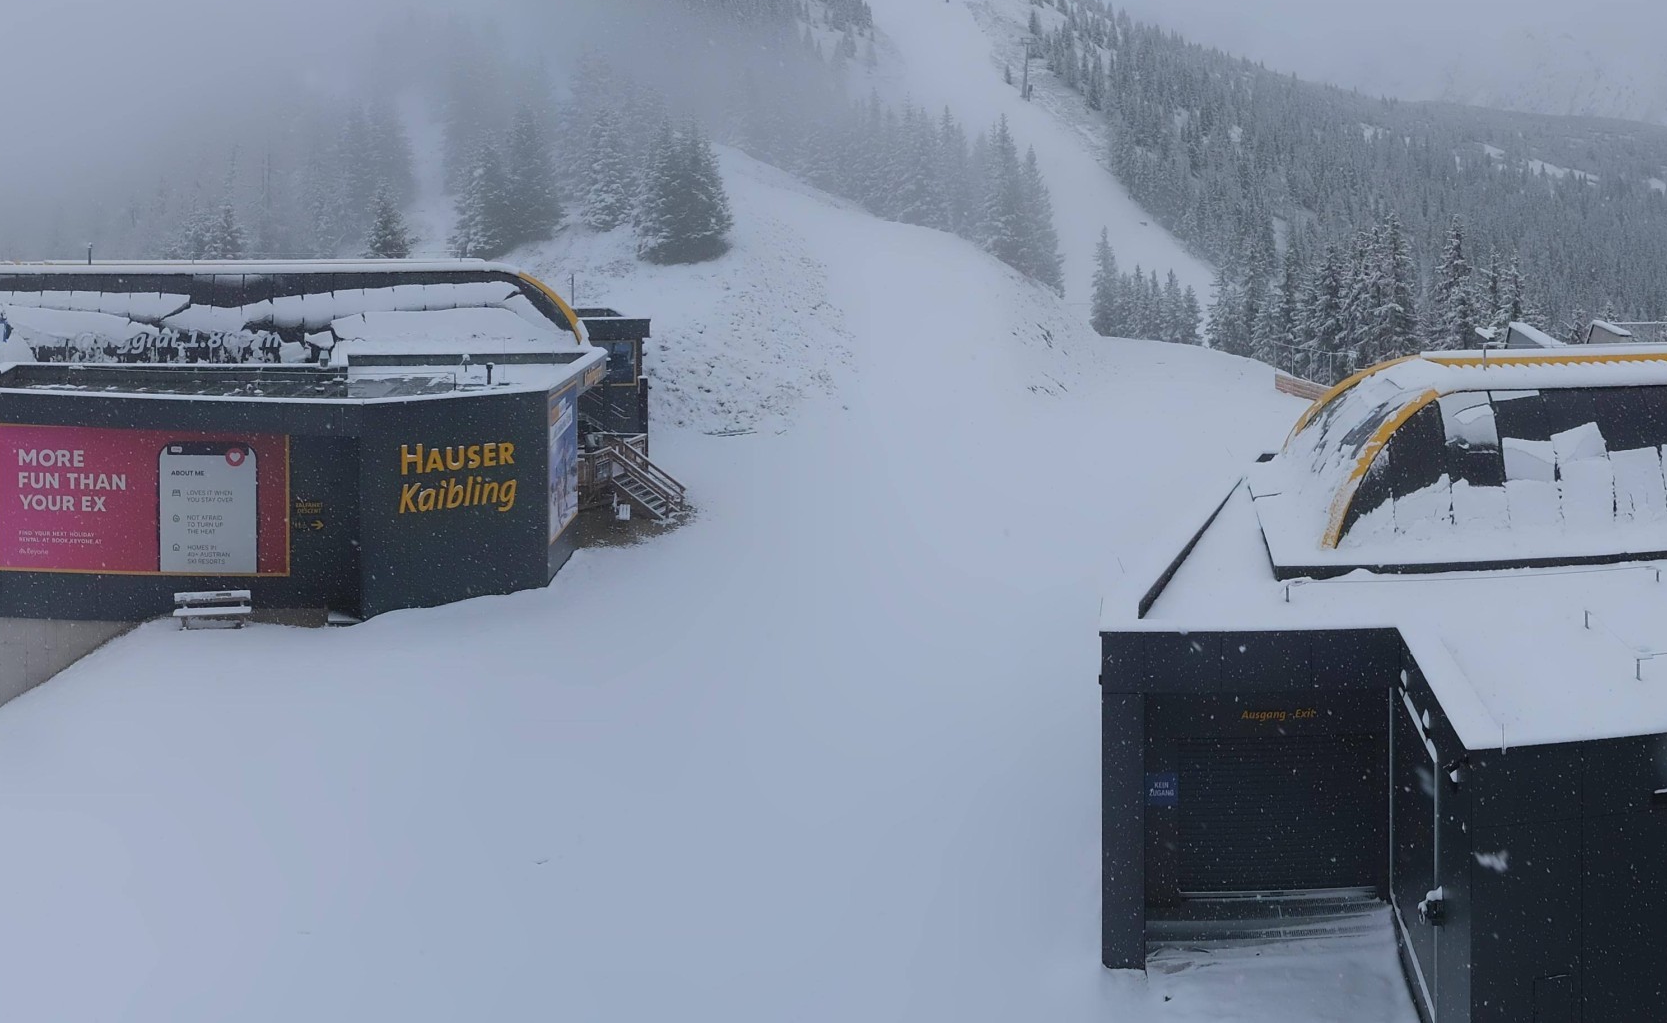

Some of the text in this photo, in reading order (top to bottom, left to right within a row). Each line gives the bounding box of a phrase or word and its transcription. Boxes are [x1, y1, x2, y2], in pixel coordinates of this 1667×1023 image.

[18, 448, 85, 468] MORE
[401, 442, 515, 475] HAUSER
[18, 472, 126, 491] FUN THAN
[20, 494, 107, 512] YOUR EX
[399, 476, 518, 514] Kaibling
[1241, 710, 1286, 722] Ausgang
[1295, 708, 1316, 718] Exit
[1149, 789, 1175, 797] ZUGANG
[1154, 781, 1169, 789] KEIN
